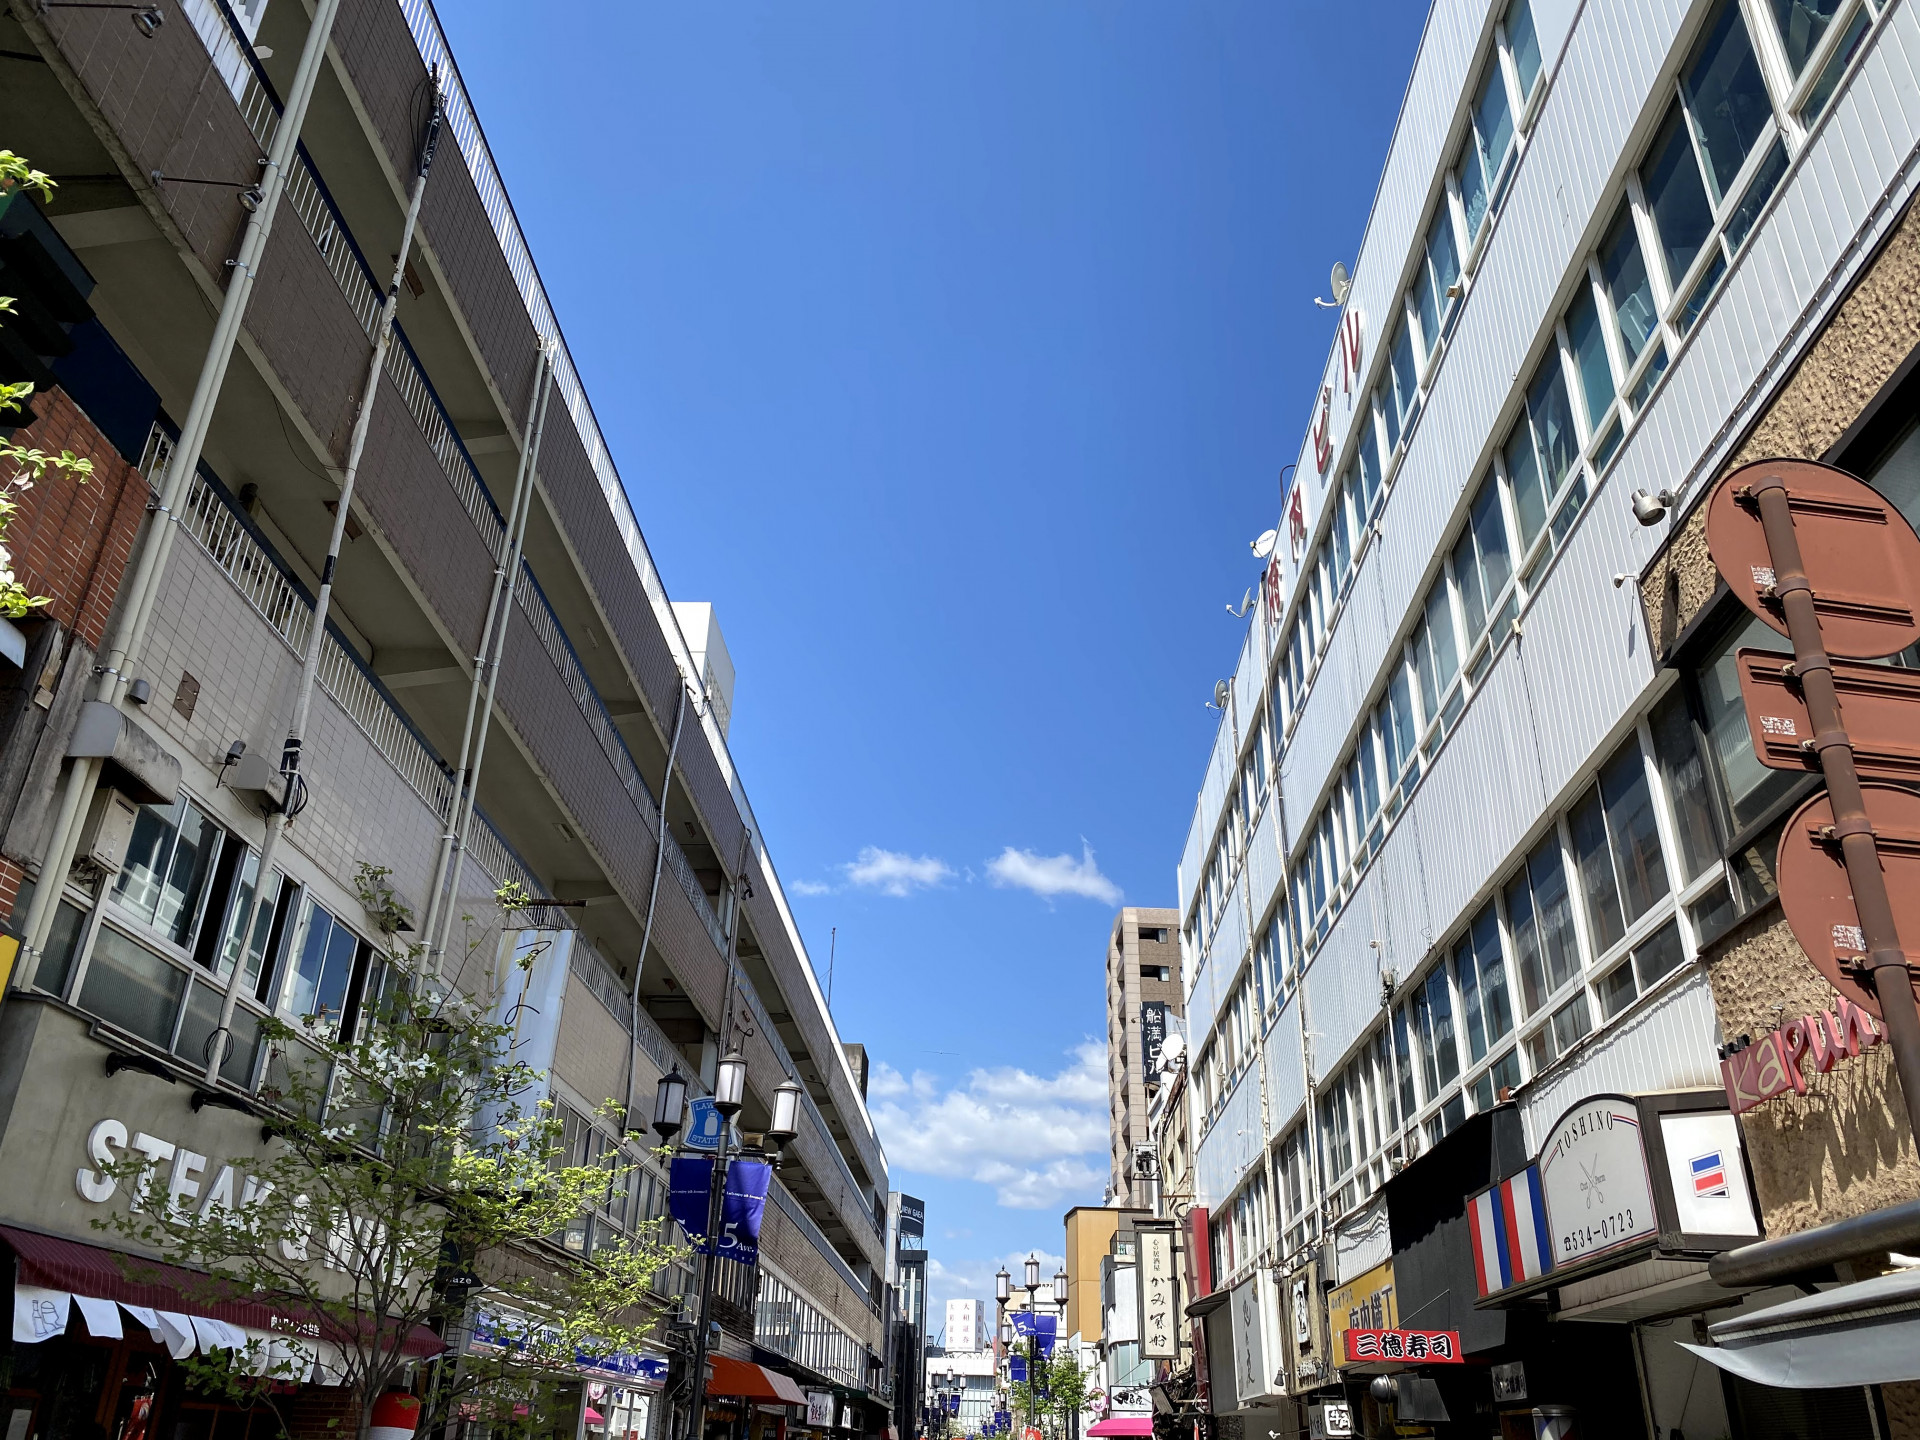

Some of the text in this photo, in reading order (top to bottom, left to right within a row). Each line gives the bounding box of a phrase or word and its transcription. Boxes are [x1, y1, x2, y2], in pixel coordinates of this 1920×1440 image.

[1556, 1110, 1614, 1158] TOSHINO
[76, 1118, 276, 1246] STEAK
[719, 1222, 755, 1253] 5 Ave.
[1572, 1208, 1634, 1251] 534-0723
[1017, 1321, 1027, 1333] 5
[1356, 1333, 1453, 1359] 三徳寿司
